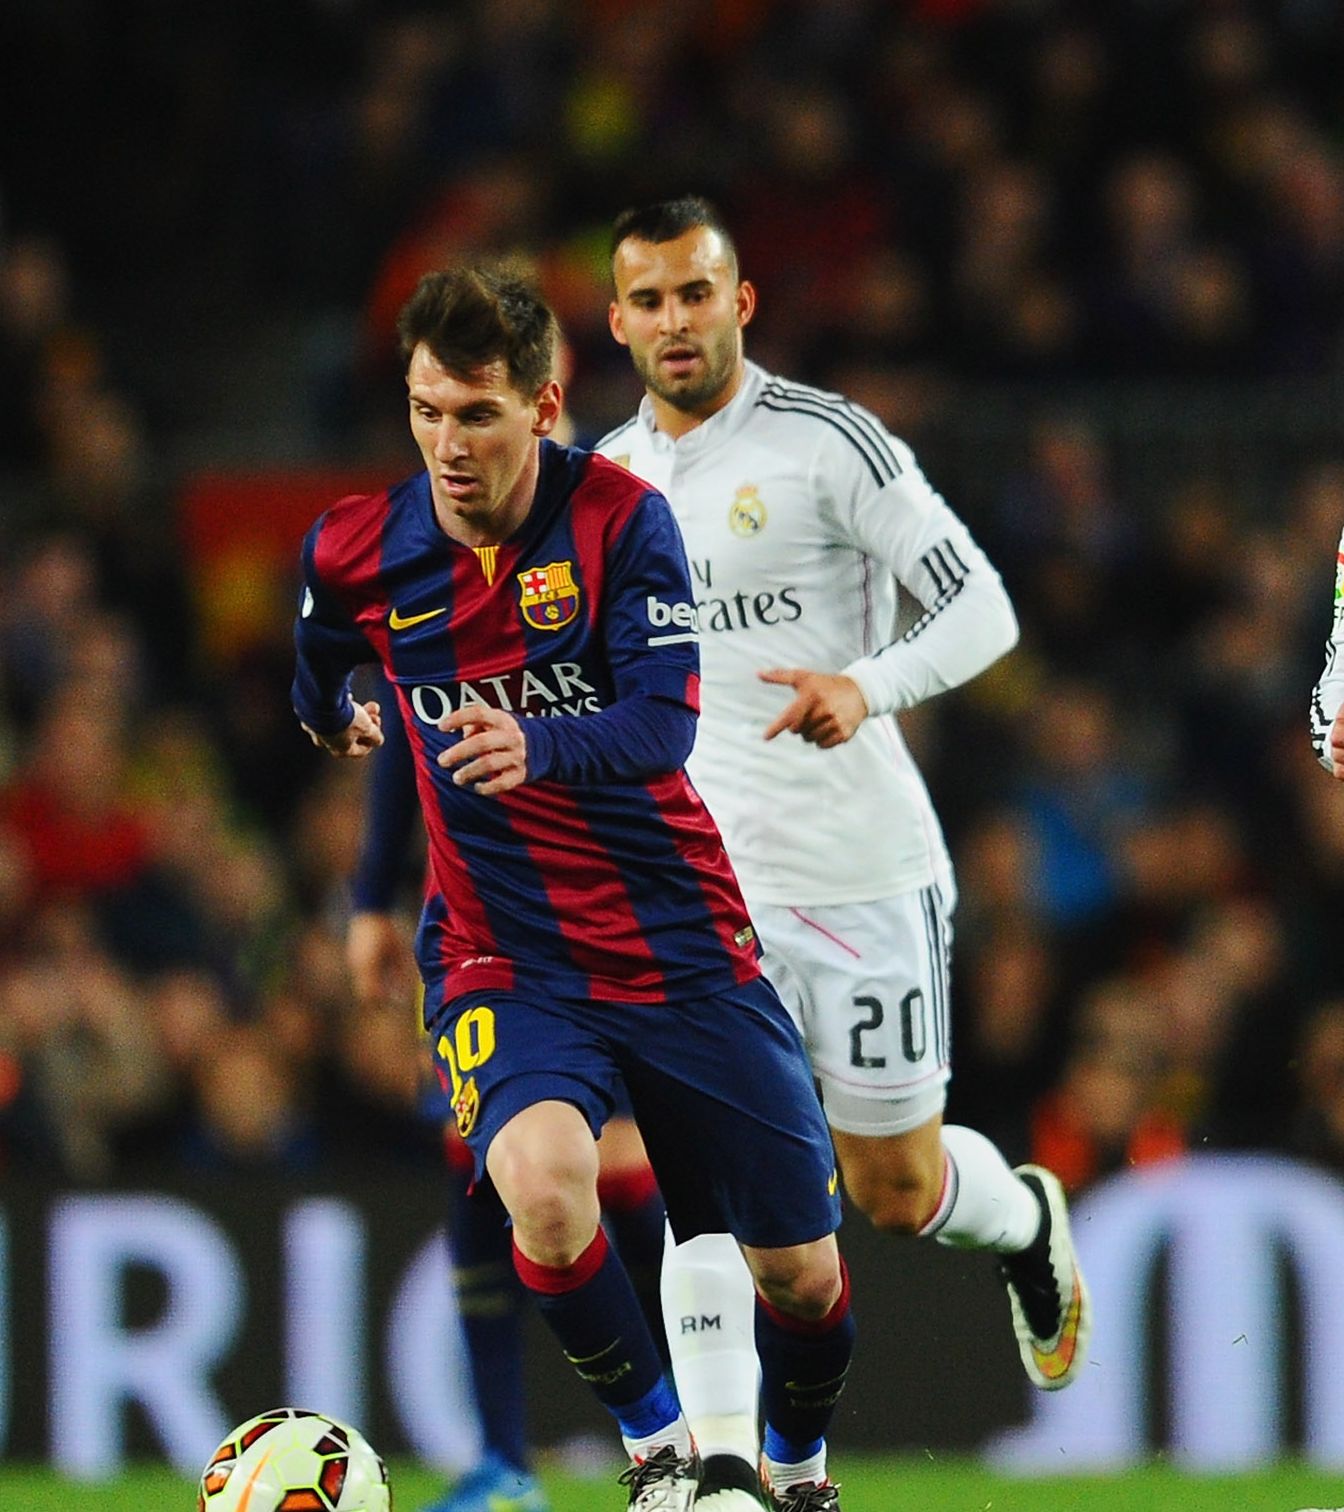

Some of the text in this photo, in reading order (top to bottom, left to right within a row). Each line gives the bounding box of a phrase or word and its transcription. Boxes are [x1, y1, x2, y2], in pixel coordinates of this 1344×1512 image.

[647, 596, 698, 633] be
[411, 661, 596, 726] QATAR
[849, 986, 927, 1069] 20
[680, 1314, 722, 1335] RM
